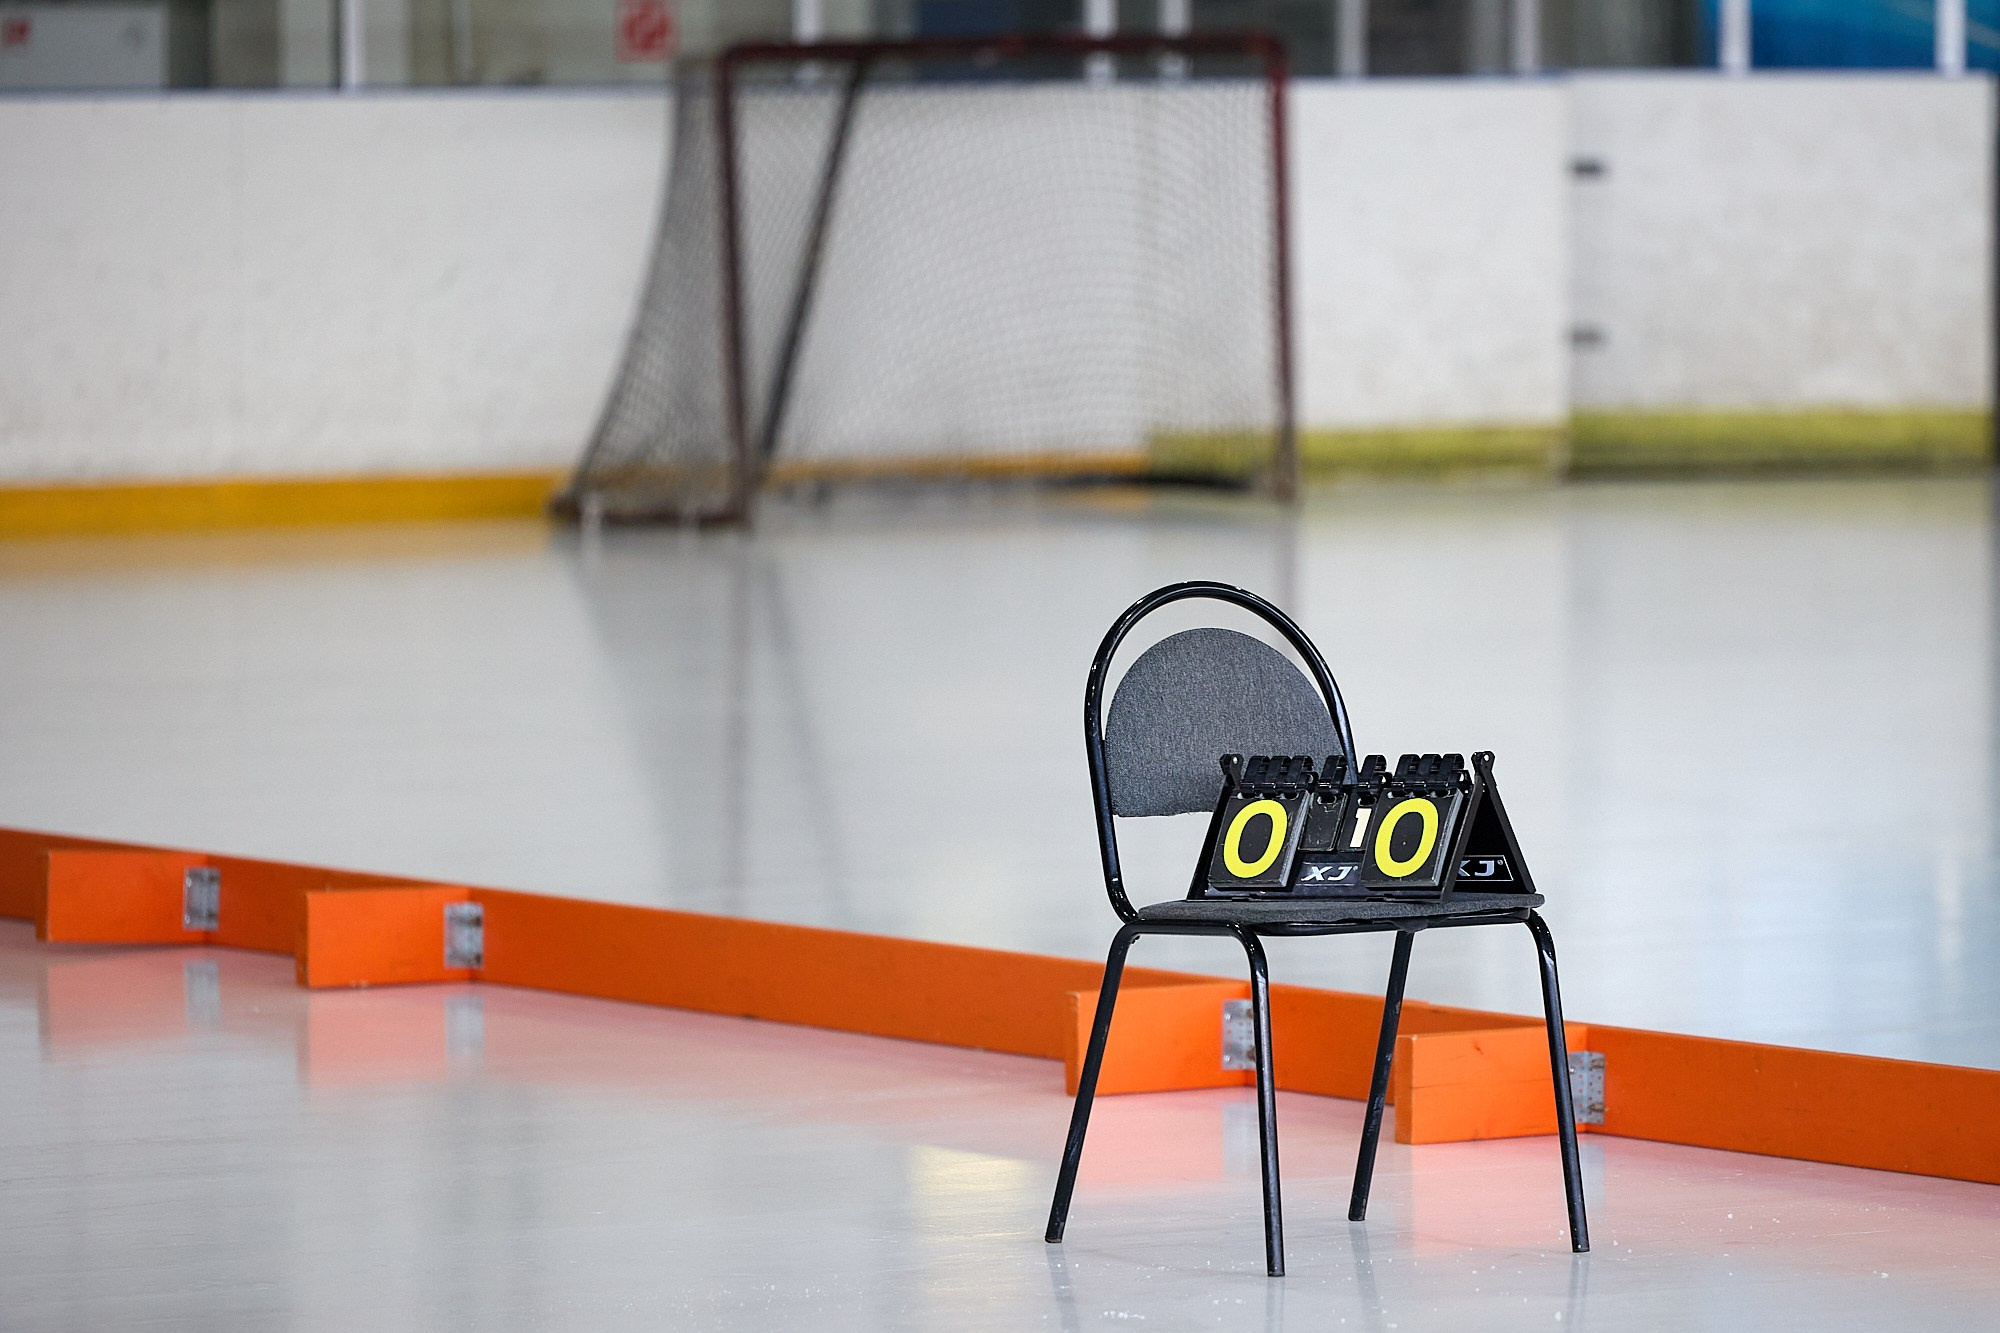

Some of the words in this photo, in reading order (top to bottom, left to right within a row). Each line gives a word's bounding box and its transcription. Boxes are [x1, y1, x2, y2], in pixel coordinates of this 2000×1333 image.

[1223, 799, 1288, 878] 0
[1350, 808, 1372, 848] 1
[1374, 797, 1439, 878] 0
